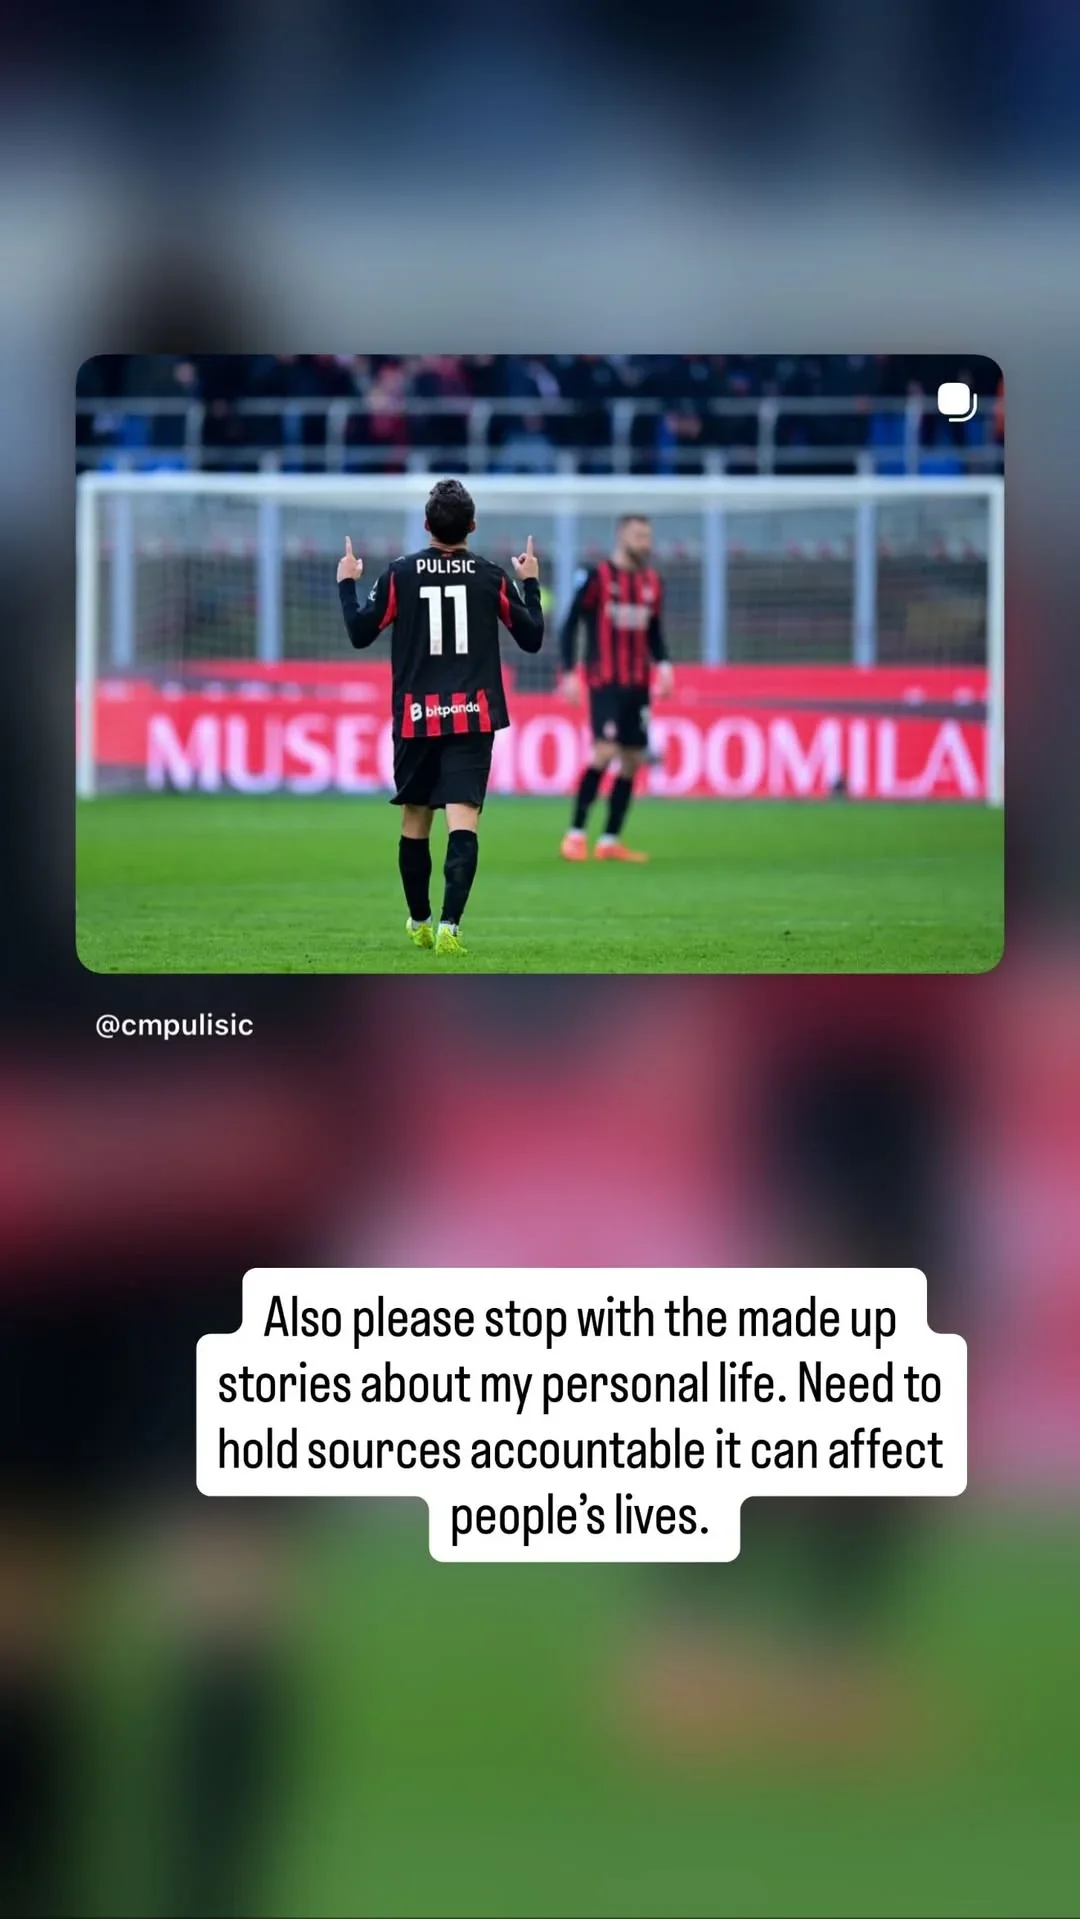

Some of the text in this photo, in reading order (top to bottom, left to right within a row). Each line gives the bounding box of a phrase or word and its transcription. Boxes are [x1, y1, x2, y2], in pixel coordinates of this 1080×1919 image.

[416, 559, 476, 574] PULISIC
[419, 584, 469, 656] 11
[425, 702, 480, 718] bitpanda
